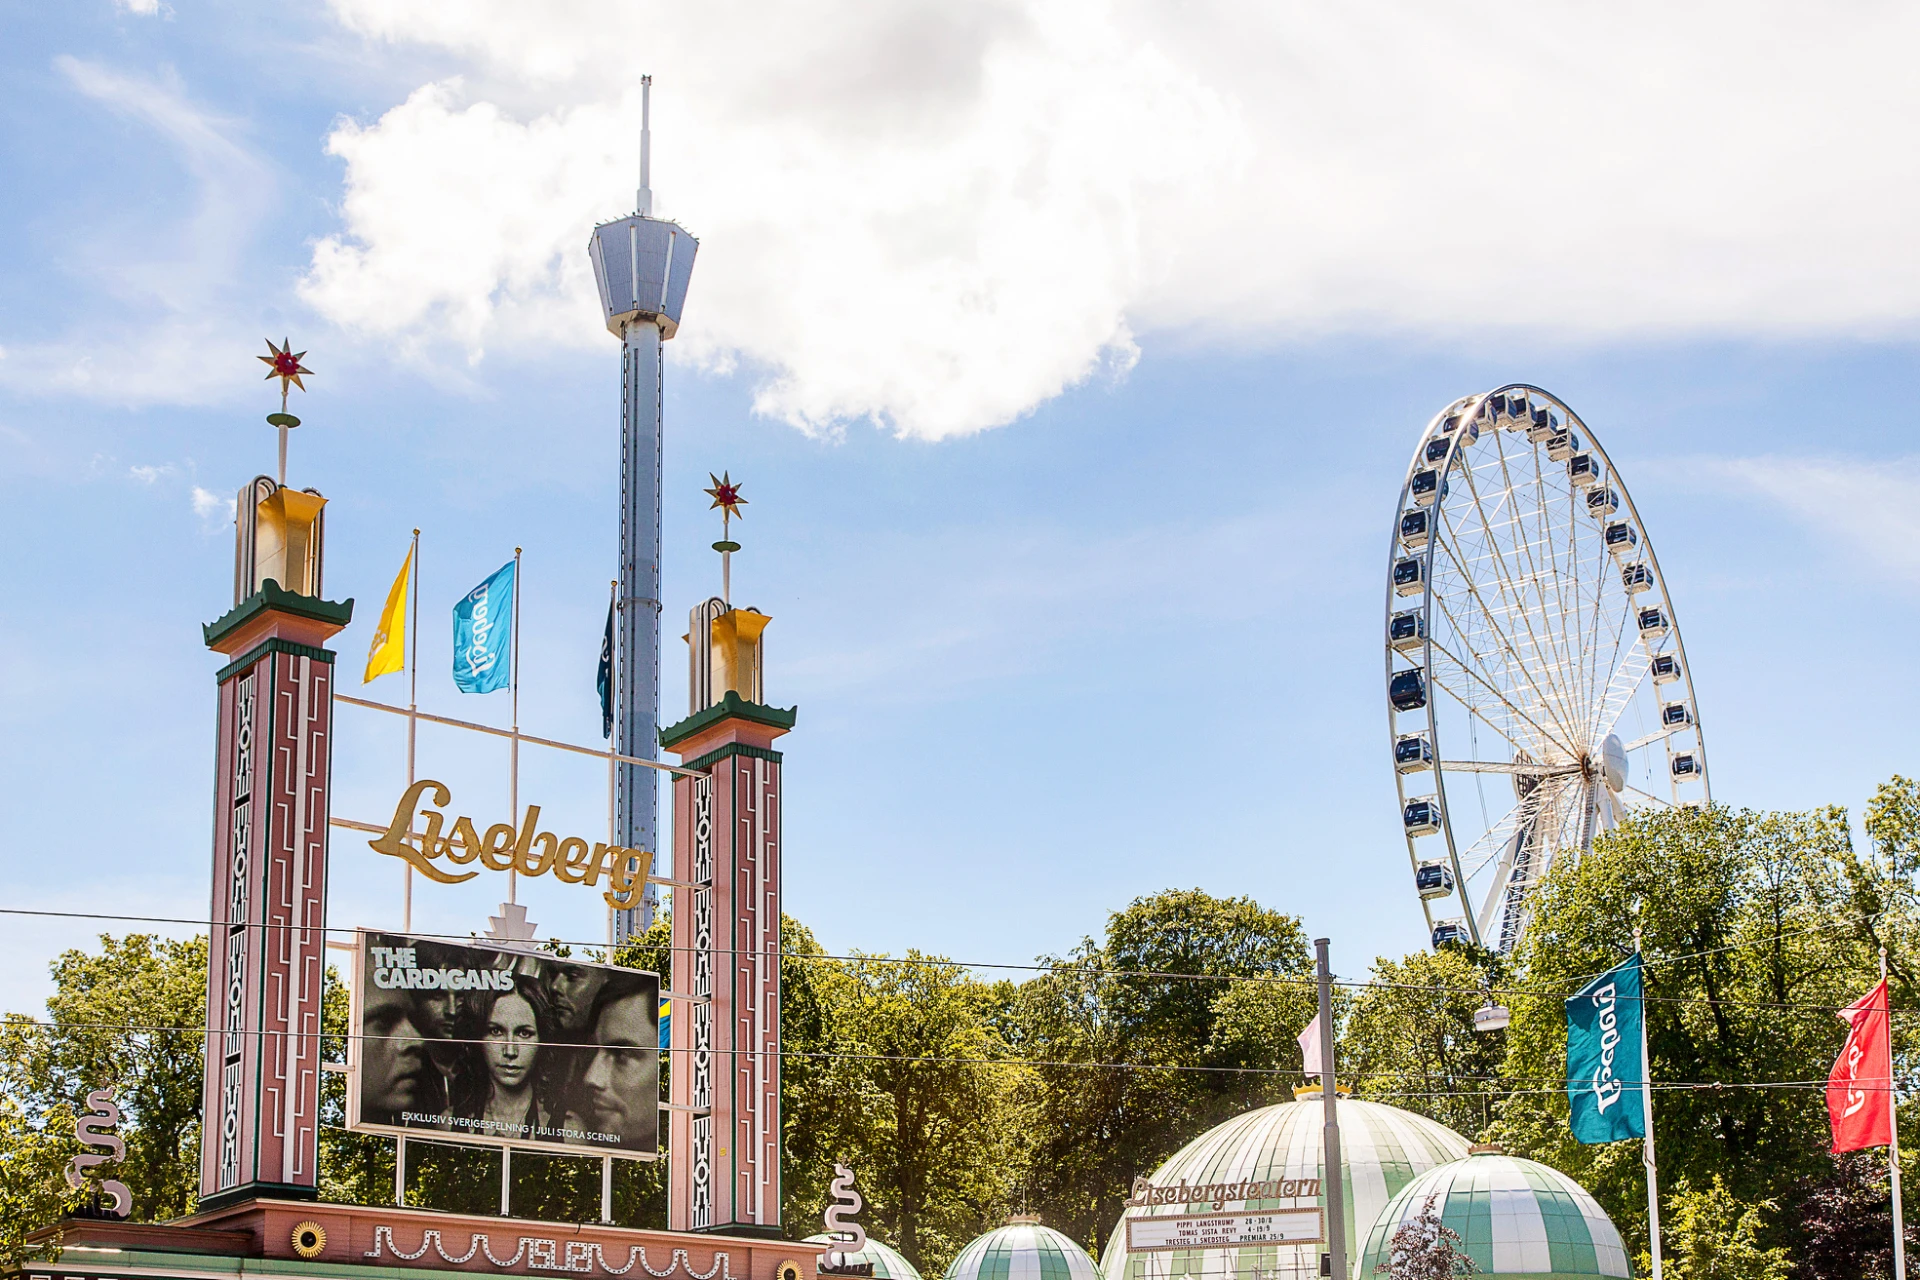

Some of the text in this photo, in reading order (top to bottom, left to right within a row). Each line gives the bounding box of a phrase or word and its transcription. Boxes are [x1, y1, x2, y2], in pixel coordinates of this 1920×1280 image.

[368, 779, 654, 911] Liseberg
[370, 947, 417, 969] THE
[373, 967, 515, 991] CARDIGANS
[401, 1111, 621, 1143] EXKLUSIV SVERIGESPELNING 1 JULI STORA SCENEN
[1123, 1175, 1323, 1212] Lisebergsteatern
[1176, 1221, 1193, 1229] PIPPI
[1179, 1229, 1198, 1237] TOMAS
[1201, 1228, 1218, 1236] SISTA
[1165, 1237, 1191, 1246] TRESTEG
[1200, 1236, 1230, 1244] SNEDSTEG
